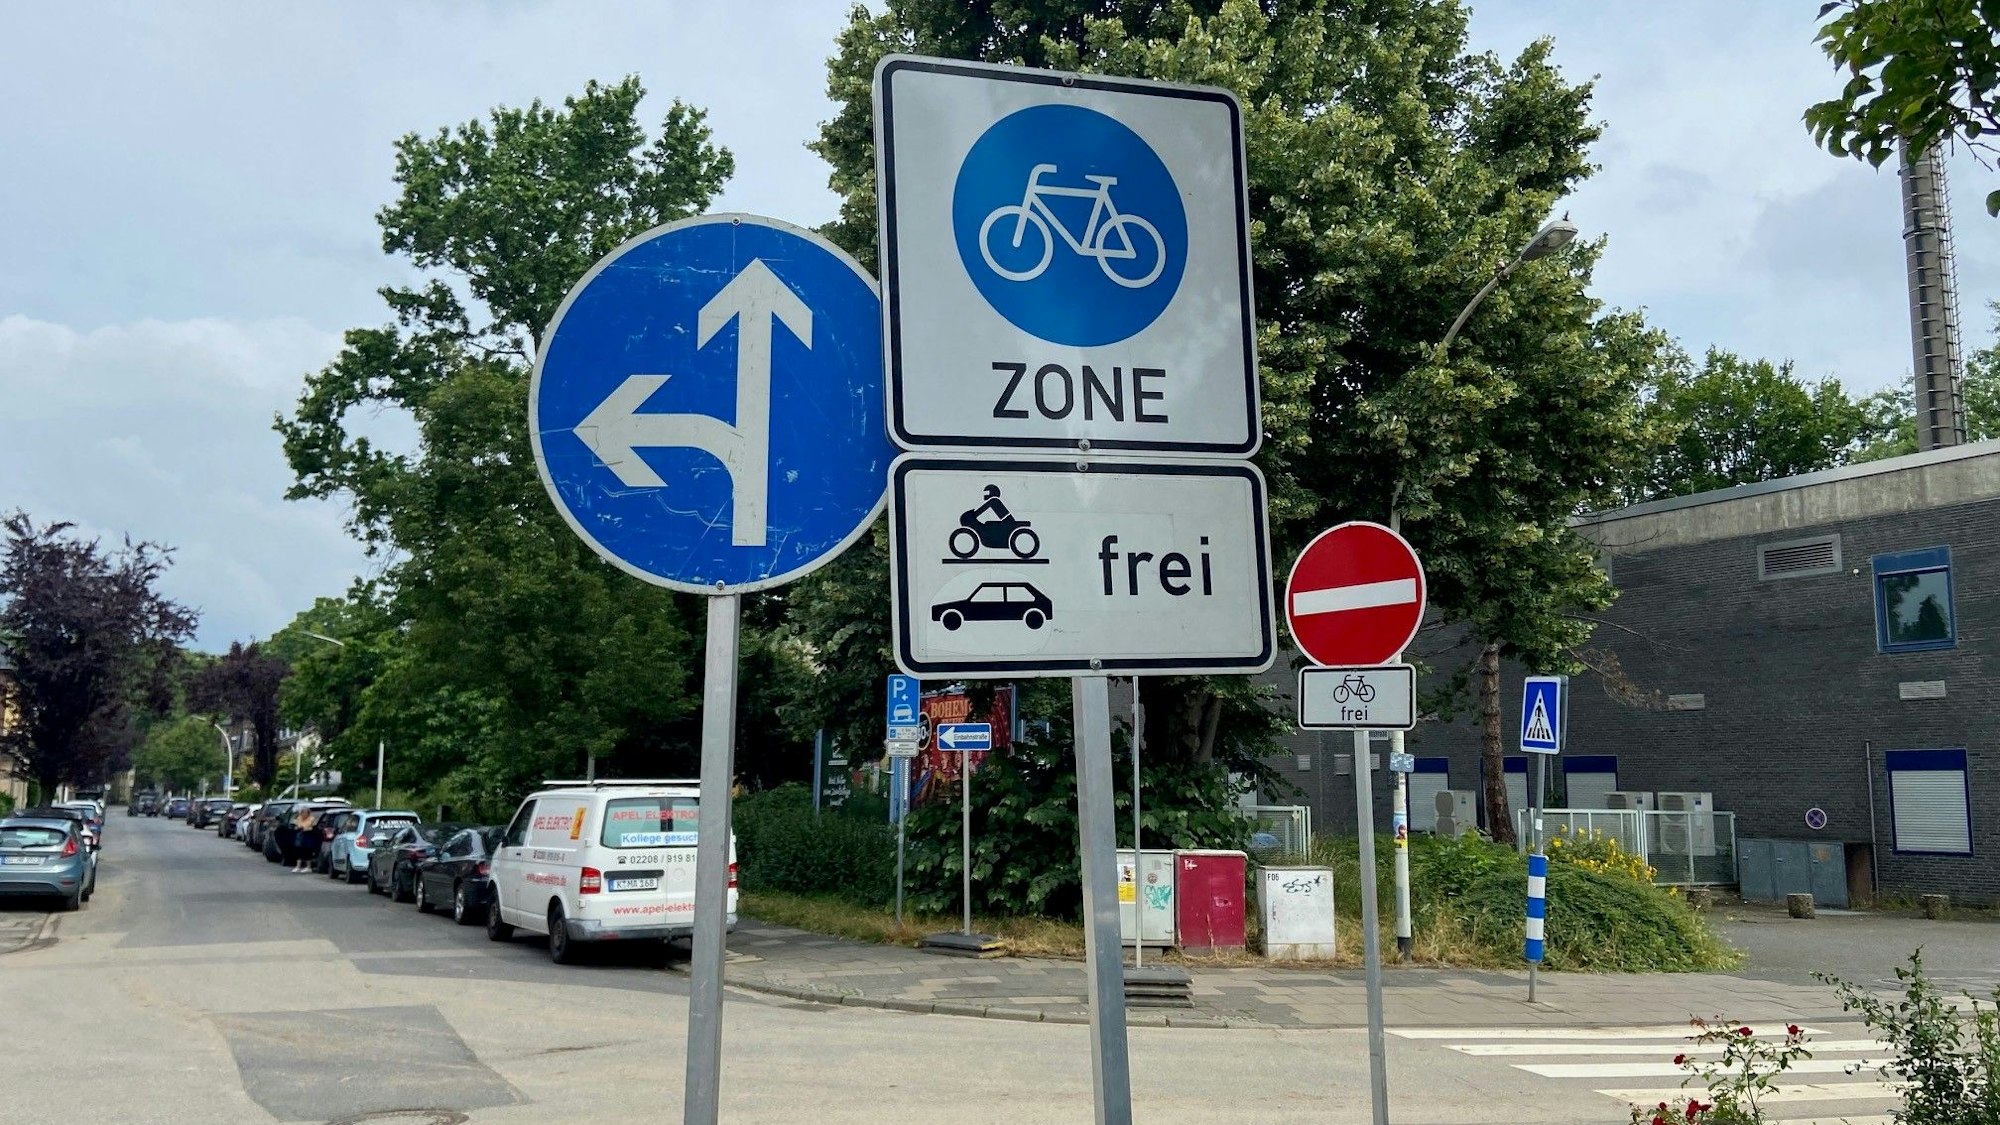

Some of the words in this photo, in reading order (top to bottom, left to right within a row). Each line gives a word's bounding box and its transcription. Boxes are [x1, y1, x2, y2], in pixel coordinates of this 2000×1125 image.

[992, 361, 1168, 424] ZONE
[1098, 534, 1212, 596] frei
[893, 678, 907, 698] P
[1341, 705, 1368, 721] frei
[954, 734, 988, 742] Einbahnstraße
[613, 810, 642, 821] APEL
[622, 834, 662, 844] Kollege
[630, 855, 659, 864] 02208
[667, 854, 683, 863] 919
